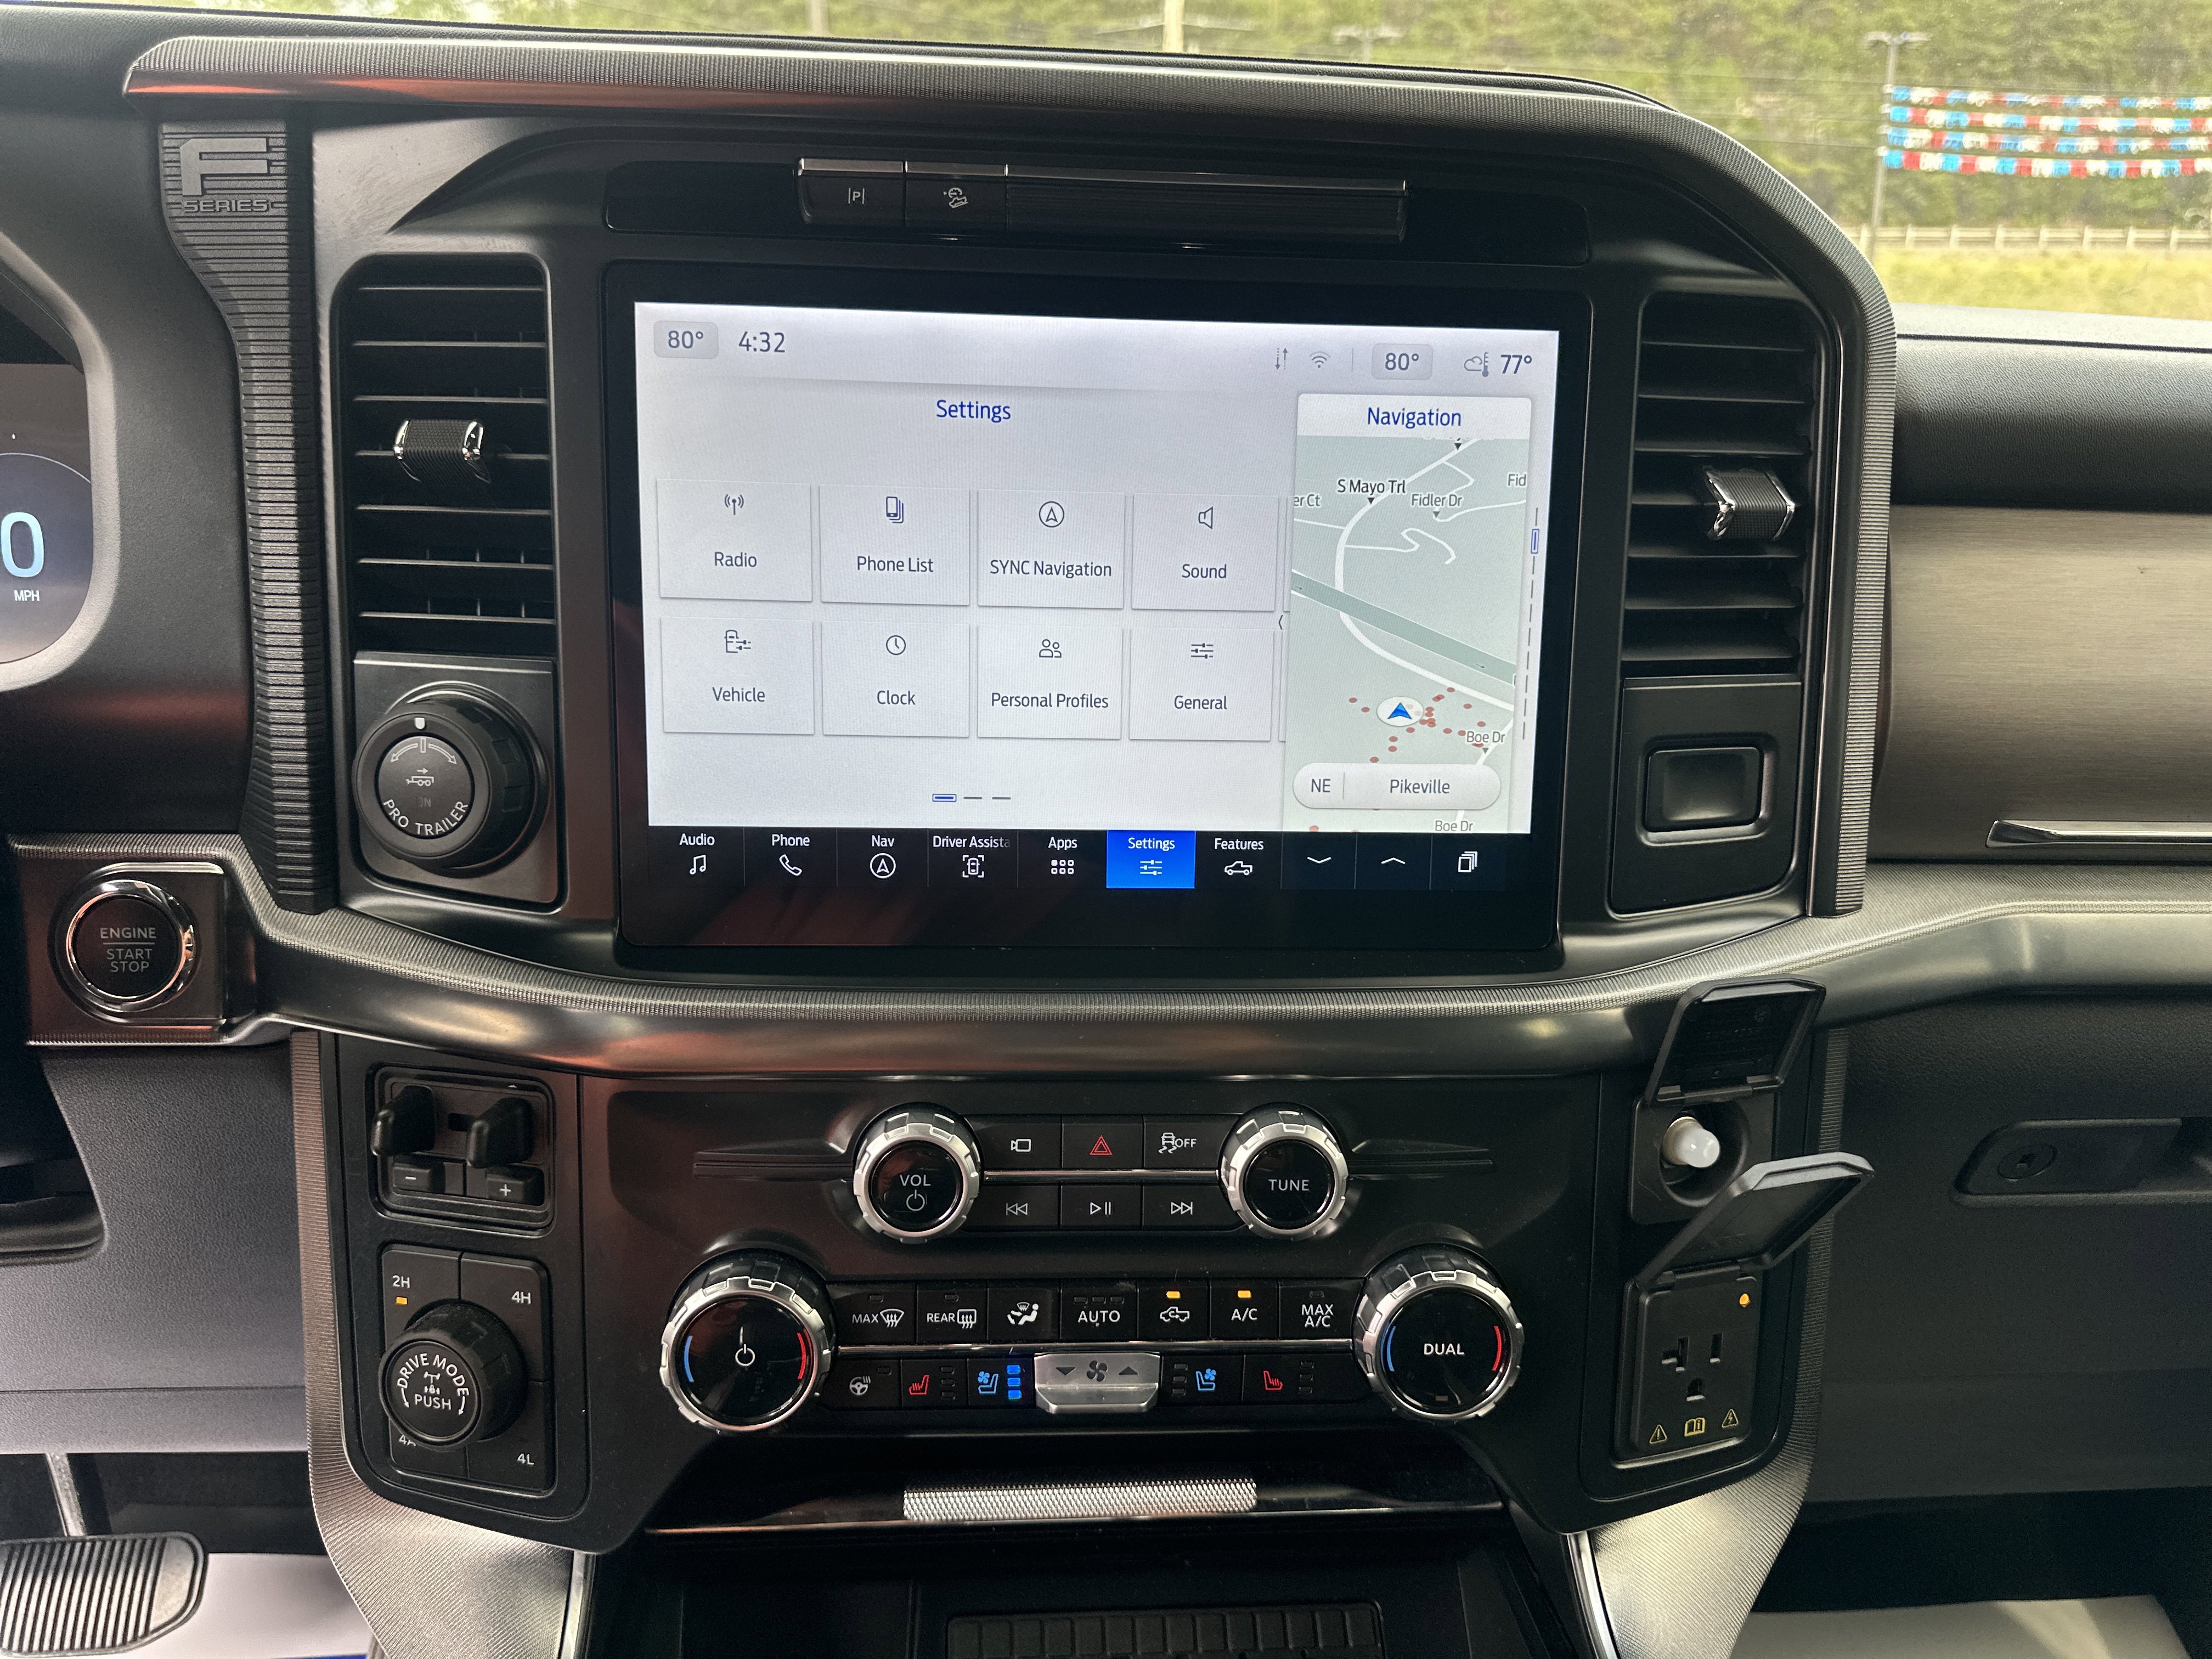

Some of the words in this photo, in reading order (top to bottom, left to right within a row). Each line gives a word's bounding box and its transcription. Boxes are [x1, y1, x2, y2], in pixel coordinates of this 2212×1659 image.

[179, 138, 268, 196] F
[183, 199, 269, 213] SERIES
[668, 330, 704, 349] 80°
[738, 331, 786, 353] 4:32
[1385, 352, 1419, 371] 80°
[1500, 354, 1532, 375] 77°
[936, 399, 1011, 423] Settings
[1367, 407, 1461, 429] Navigation
[1508, 473, 1527, 487] Fid
[1337, 479, 1346, 493] S
[1349, 479, 1385, 496] Mayo
[1388, 479, 1406, 494] Trl
[1307, 494, 1321, 507] Ct
[1412, 493, 1447, 506] Fidler
[1448, 494, 1463, 506] Dr
[1, 512, 44, 578] 0
[714, 551, 757, 568] Radio
[857, 555, 905, 572] Phone
[908, 557, 934, 573] List
[990, 560, 1030, 575] SYNC
[1034, 560, 1111, 579] Navigation
[1182, 563, 1227, 579] Sound
[14, 590, 40, 601] MPH
[712, 686, 765, 702] Vehicle
[877, 690, 916, 706] Clock
[991, 692, 1053, 707] Personal
[1057, 693, 1109, 708] Profiles
[1174, 695, 1227, 710] General
[1466, 731, 1489, 743] Boe
[1492, 731, 1506, 743] Dr
[1311, 778, 1331, 793] NE
[1390, 778, 1450, 794] Pikeville
[383, 798, 409, 828] PRO
[415, 800, 469, 836] TRAILER
[1435, 820, 1458, 832] Boe
[1460, 820, 1474, 832] Dr
[679, 833, 715, 846] Audio
[771, 833, 810, 847] Phone
[871, 834, 895, 847] Nav
[933, 835, 967, 848] Driver
[1048, 836, 1077, 850] Apps
[1128, 837, 1175, 851] Settings
[1214, 838, 1264, 850] Features
[100, 927, 156, 939] ENGINE
[106, 948, 153, 960] START
[110, 961, 149, 973] STOP
[1175, 1138, 1197, 1150] OFF
[899, 1174, 931, 1187] VOL
[1268, 1179, 1310, 1191] TUNE
[392, 1275, 410, 1289] 2H
[511, 1291, 531, 1304] 4H
[1077, 1310, 1120, 1323] AUTO
[1231, 1307, 1257, 1322] A/C
[1301, 1304, 1334, 1316] MAX
[852, 1313, 879, 1323] MAX
[927, 1312, 955, 1323] REAR
[1304, 1315, 1330, 1328] A/C
[1424, 1343, 1465, 1355] DUAL
[397, 1353, 429, 1389] DRIVE
[432, 1355, 470, 1397] MODE
[414, 1393, 452, 1410] PUSH
[517, 1453, 534, 1466] 4L
